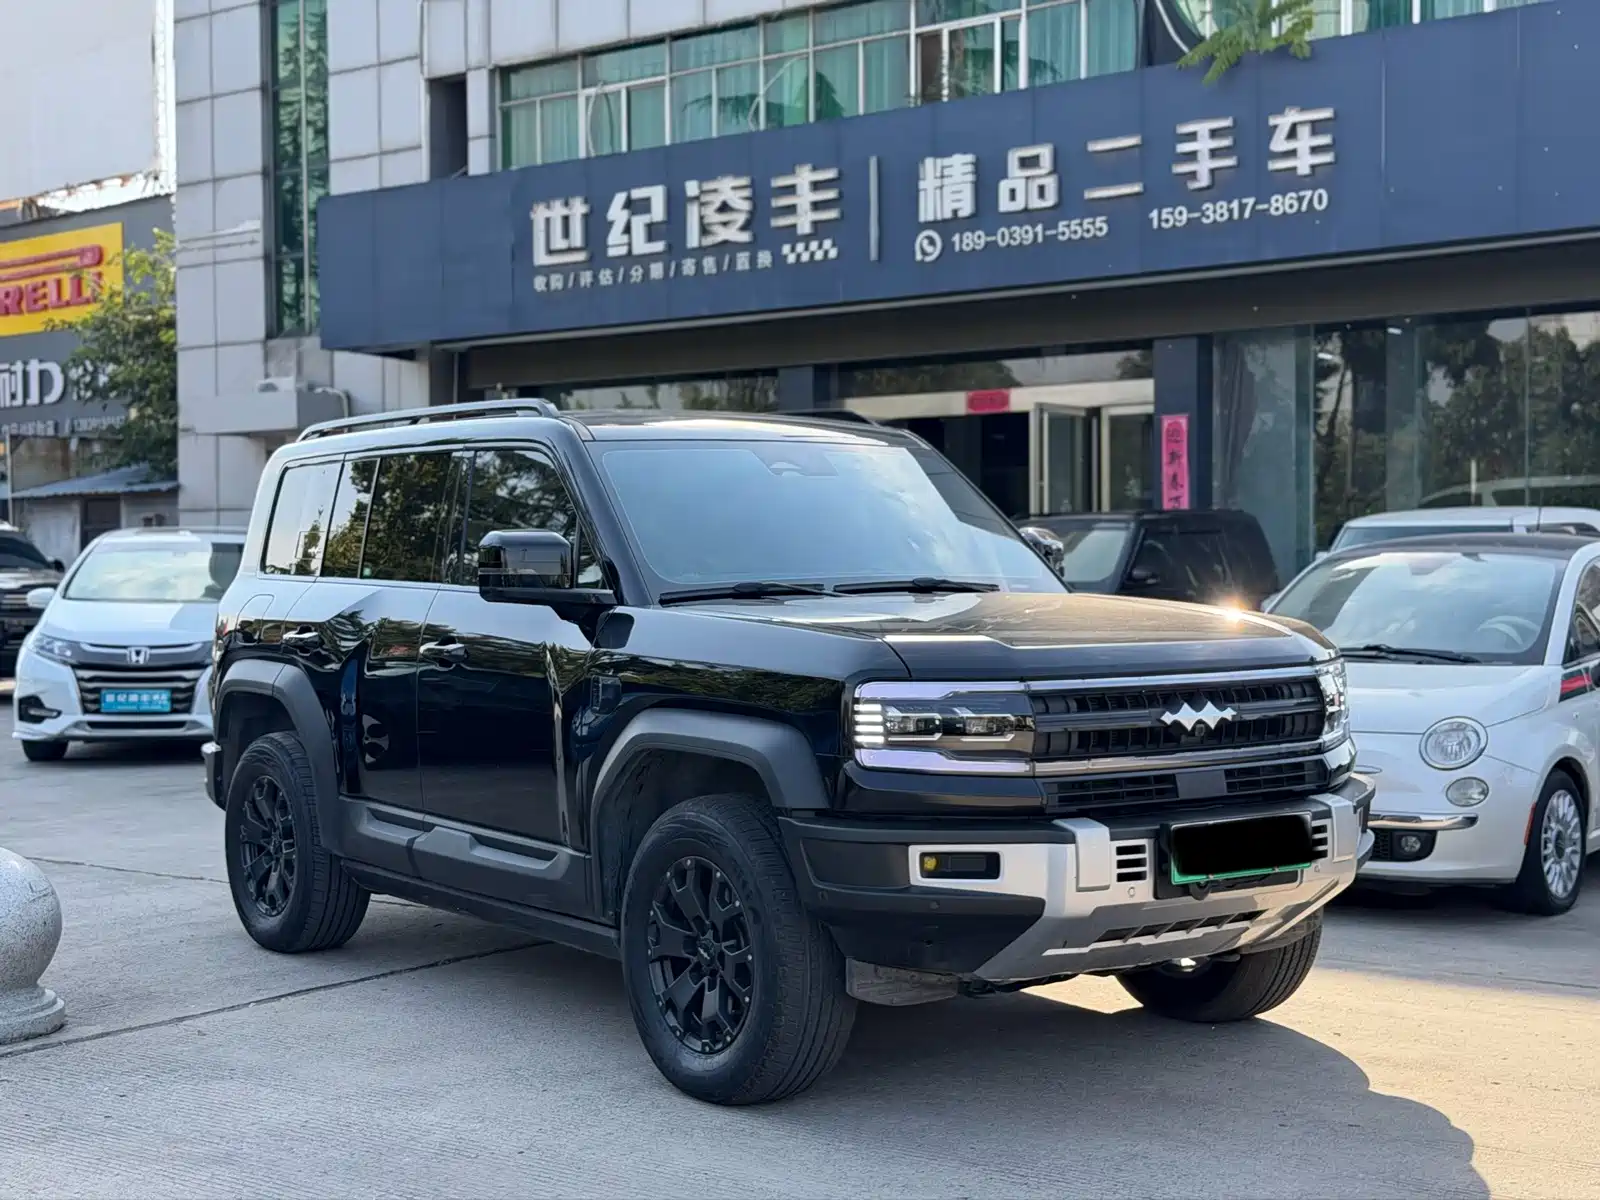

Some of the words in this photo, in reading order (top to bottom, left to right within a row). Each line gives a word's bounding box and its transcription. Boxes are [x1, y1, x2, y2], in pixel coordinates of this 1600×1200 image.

[917, 105, 1336, 223] 精品二手车
[530, 163, 842, 267] 世纪凌丰
[950, 215, 1109, 253] 189-0391-5555
[1148, 188, 1329, 230] 159-3817-8670
